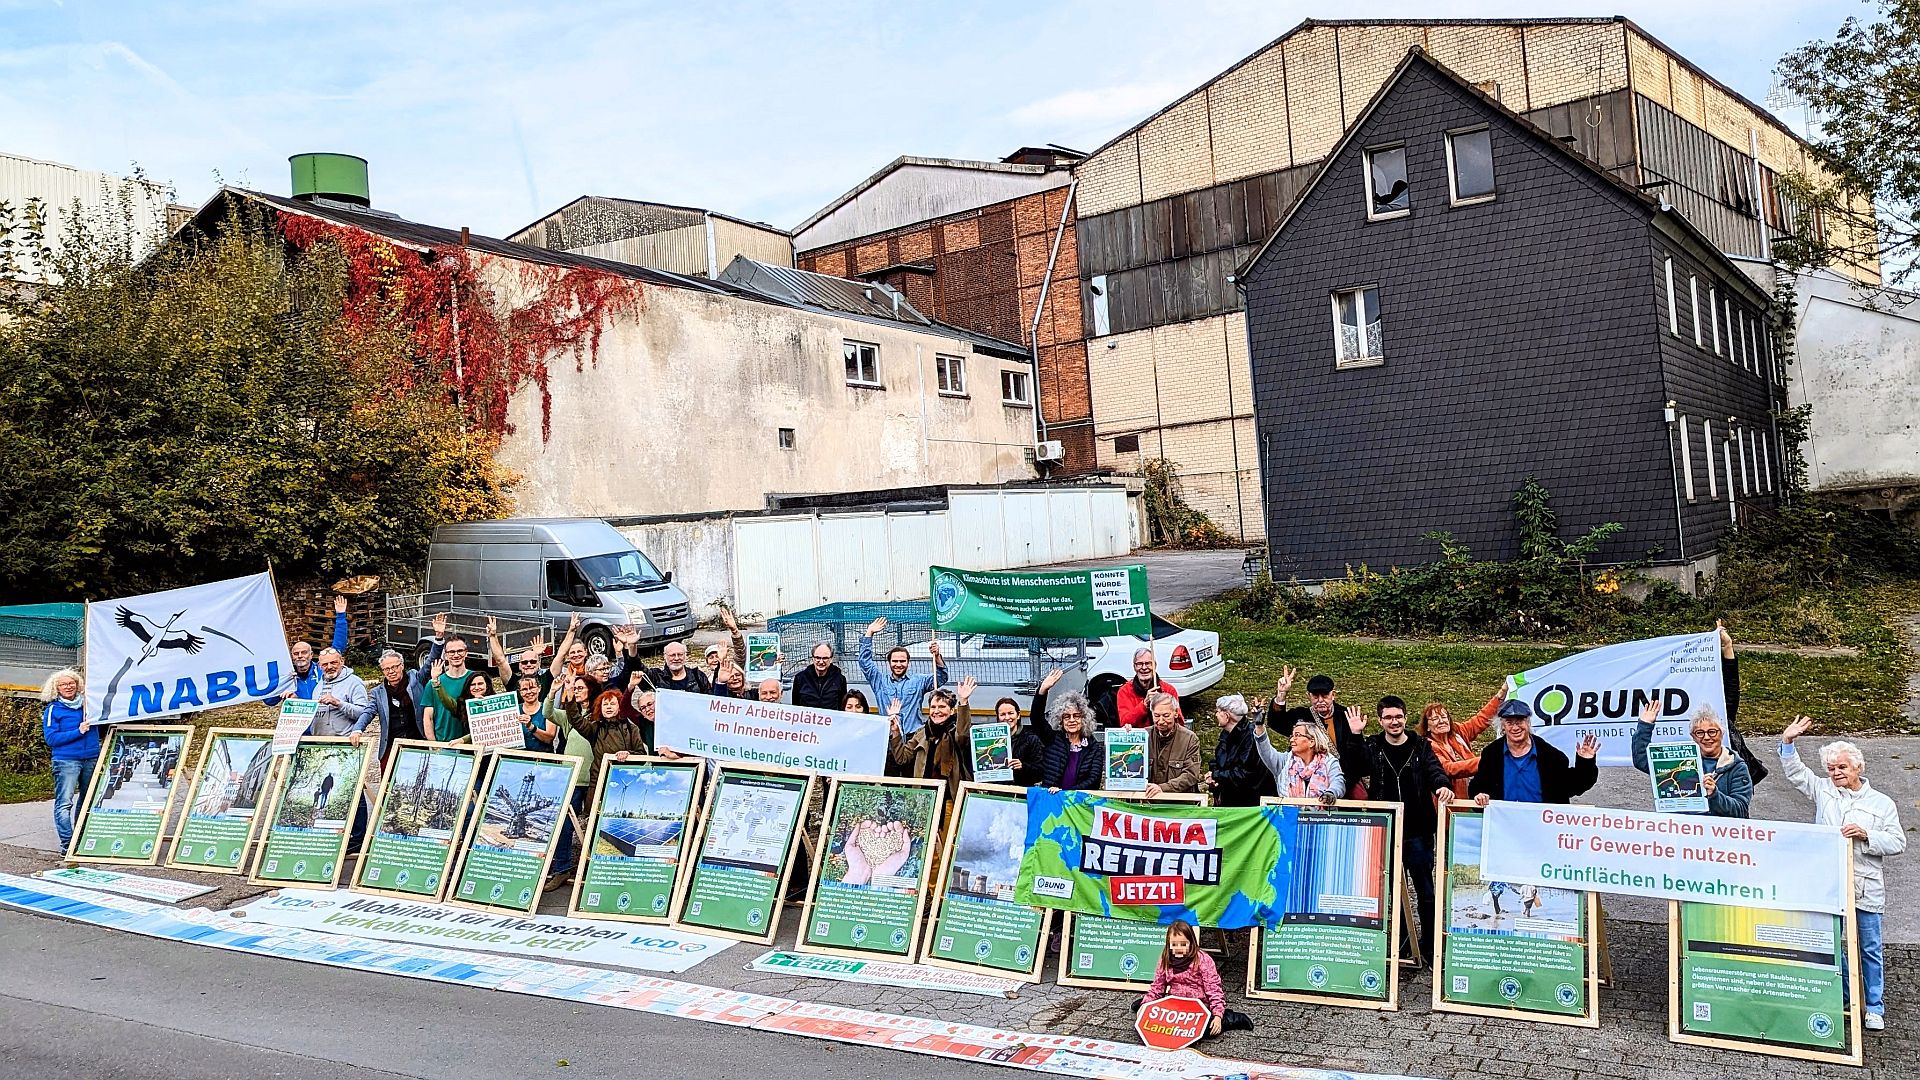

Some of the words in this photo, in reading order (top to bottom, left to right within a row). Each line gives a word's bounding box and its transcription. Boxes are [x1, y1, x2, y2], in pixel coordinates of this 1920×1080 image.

[962, 574, 1000, 586] Klimaschutz
[1001, 576, 1010, 586] ist
[1012, 576, 1086, 586] Menschenschutz
[1094, 580, 1122, 588] WÜRDE
[1104, 606, 1144, 619] JETZT.
[1670, 656, 1714, 664] Naturschutz
[1670, 665, 1716, 674] Deutschland
[128, 660, 279, 717] NABU
[1578, 688, 1690, 719] BUND
[471, 716, 501, 728] STOPPT
[503, 712, 518, 722] DEN
[709, 700, 742, 715] Mehr
[746, 705, 832, 726] Arbeitsplätze
[474, 732, 500, 742] DURCH
[501, 728, 521, 737] NEUE
[714, 720, 729, 733] im
[734, 722, 820, 744] Innenbereich.
[1576, 728, 1624, 738] FREUNDE
[689, 738, 708, 751] Für
[712, 745, 736, 757] eine
[740, 746, 800, 767] lebendige
[804, 756, 839, 771] Stadt
[843, 760, 847, 771] !
[1100, 810, 1208, 846] KLIMA
[1542, 810, 1704, 836] Gewerbebrachen
[1712, 825, 1776, 842] weiter
[1558, 834, 1584, 850] für
[1590, 836, 1675, 858] Gewerbe
[1683, 848, 1757, 866] nutzen.
[1084, 842, 1218, 882] RETTEN!
[1044, 881, 1066, 890] BUND
[1541, 863, 1656, 889] Grünflächen
[1663, 874, 1764, 900] bewahren
[1772, 885, 1777, 900] !
[1117, 882, 1176, 900] JETZT!
[270, 896, 310, 907] VCD
[340, 898, 449, 922] Mobilität
[455, 912, 489, 925] für
[492, 915, 628, 940] Menschen
[321, 912, 510, 944] Verkehrswende
[510, 932, 599, 952] Jetzt!
[630, 935, 680, 949] VCD
[858, 970, 894, 980] DURCH
[895, 973, 920, 981] NEUE
[864, 965, 909, 974] STOPPT
[909, 968, 932, 976] DEN
[1692, 966, 1756, 979] Lebensraumzerstörung
[1770, 973, 1797, 982] Raubbau
[1692, 973, 1729, 983] Ökosystemen
[1731, 978, 1745, 986] sind,
[1777, 982, 1811, 993] Klimakrise,
[1714, 983, 1750, 992] Verursacher
[1762, 989, 1807, 999] Artensterbens.
[1148, 1005, 1204, 1026] STOPPT
[1143, 1019, 1196, 1038] Landfraß
